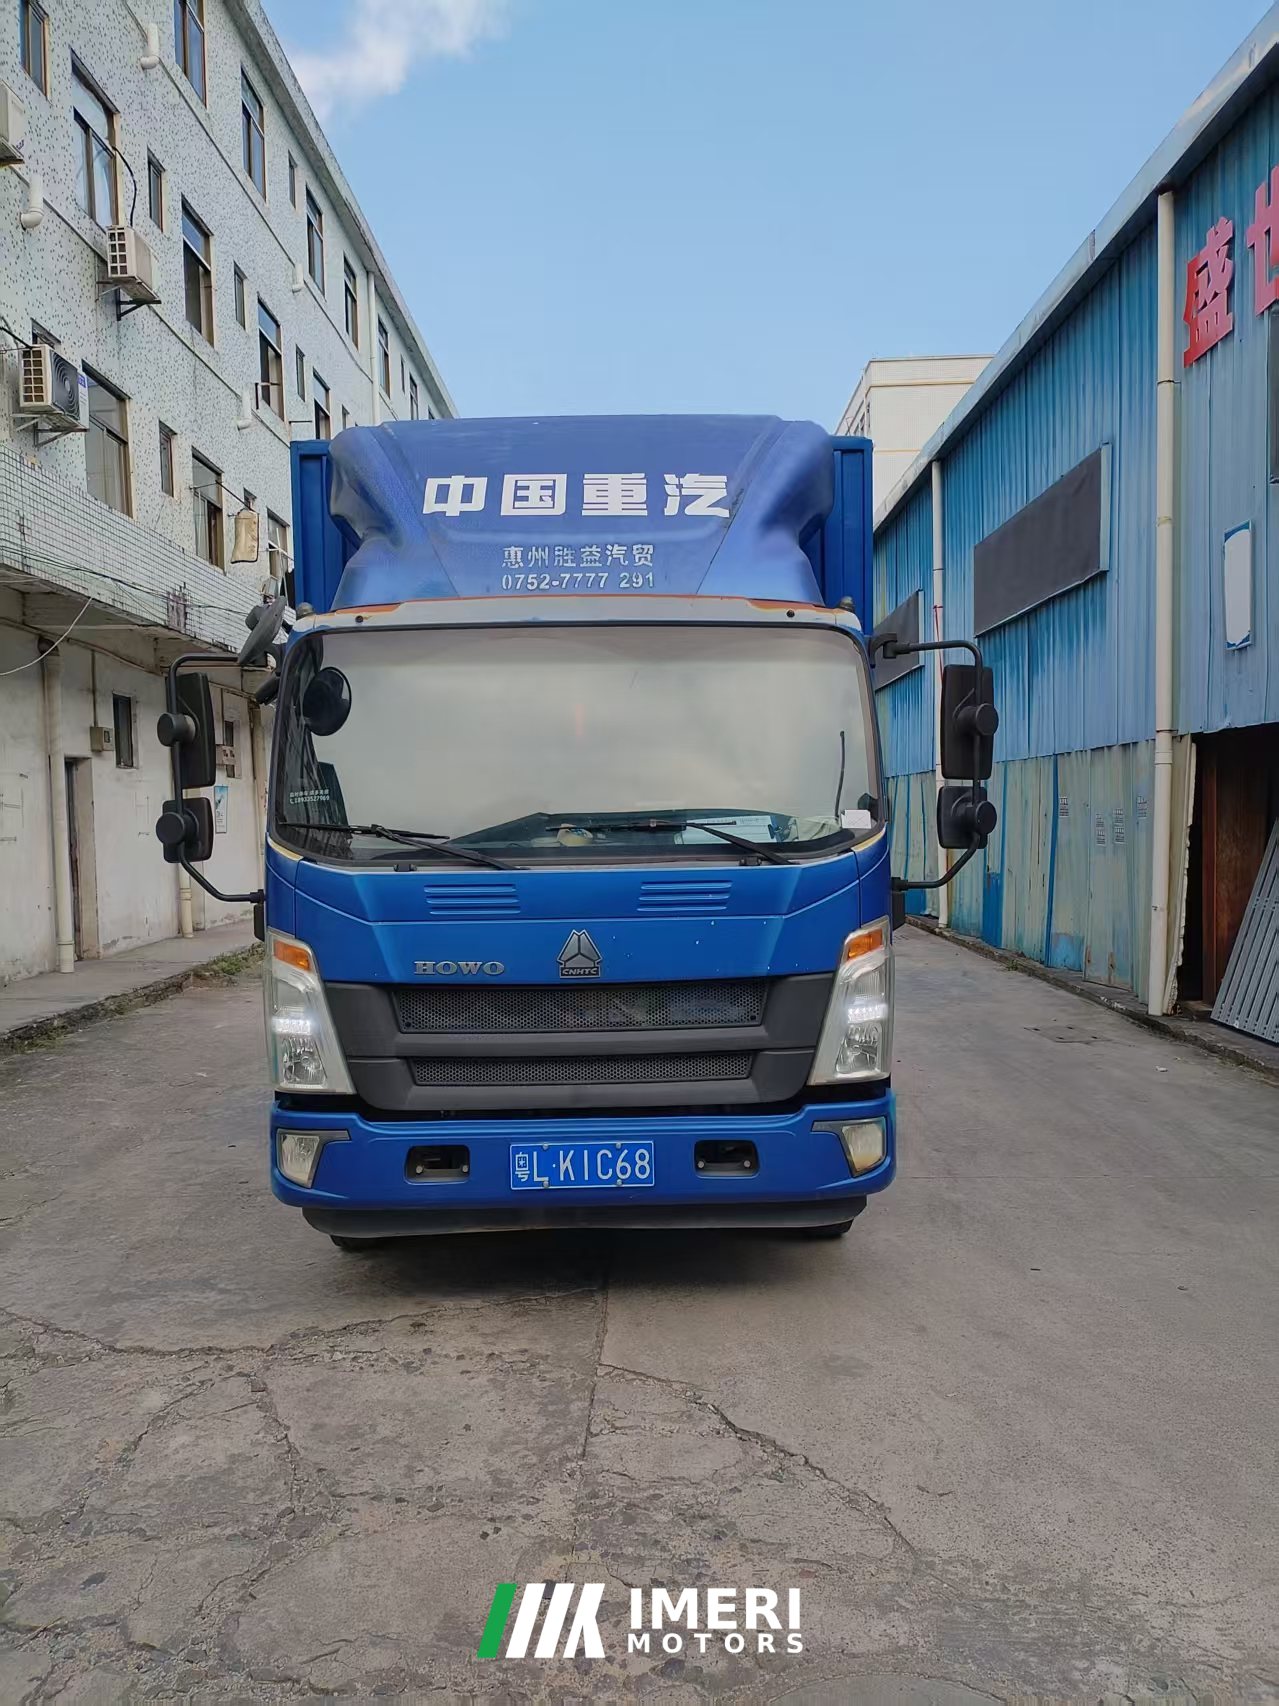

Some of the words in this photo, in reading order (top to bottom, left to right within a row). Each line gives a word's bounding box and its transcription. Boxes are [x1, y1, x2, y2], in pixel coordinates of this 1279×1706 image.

[423, 473, 730, 518] 中国重汽
[502, 573, 608, 590] 0752-7777
[619, 572, 654, 588] 291
[414, 961, 505, 976] HOWO
